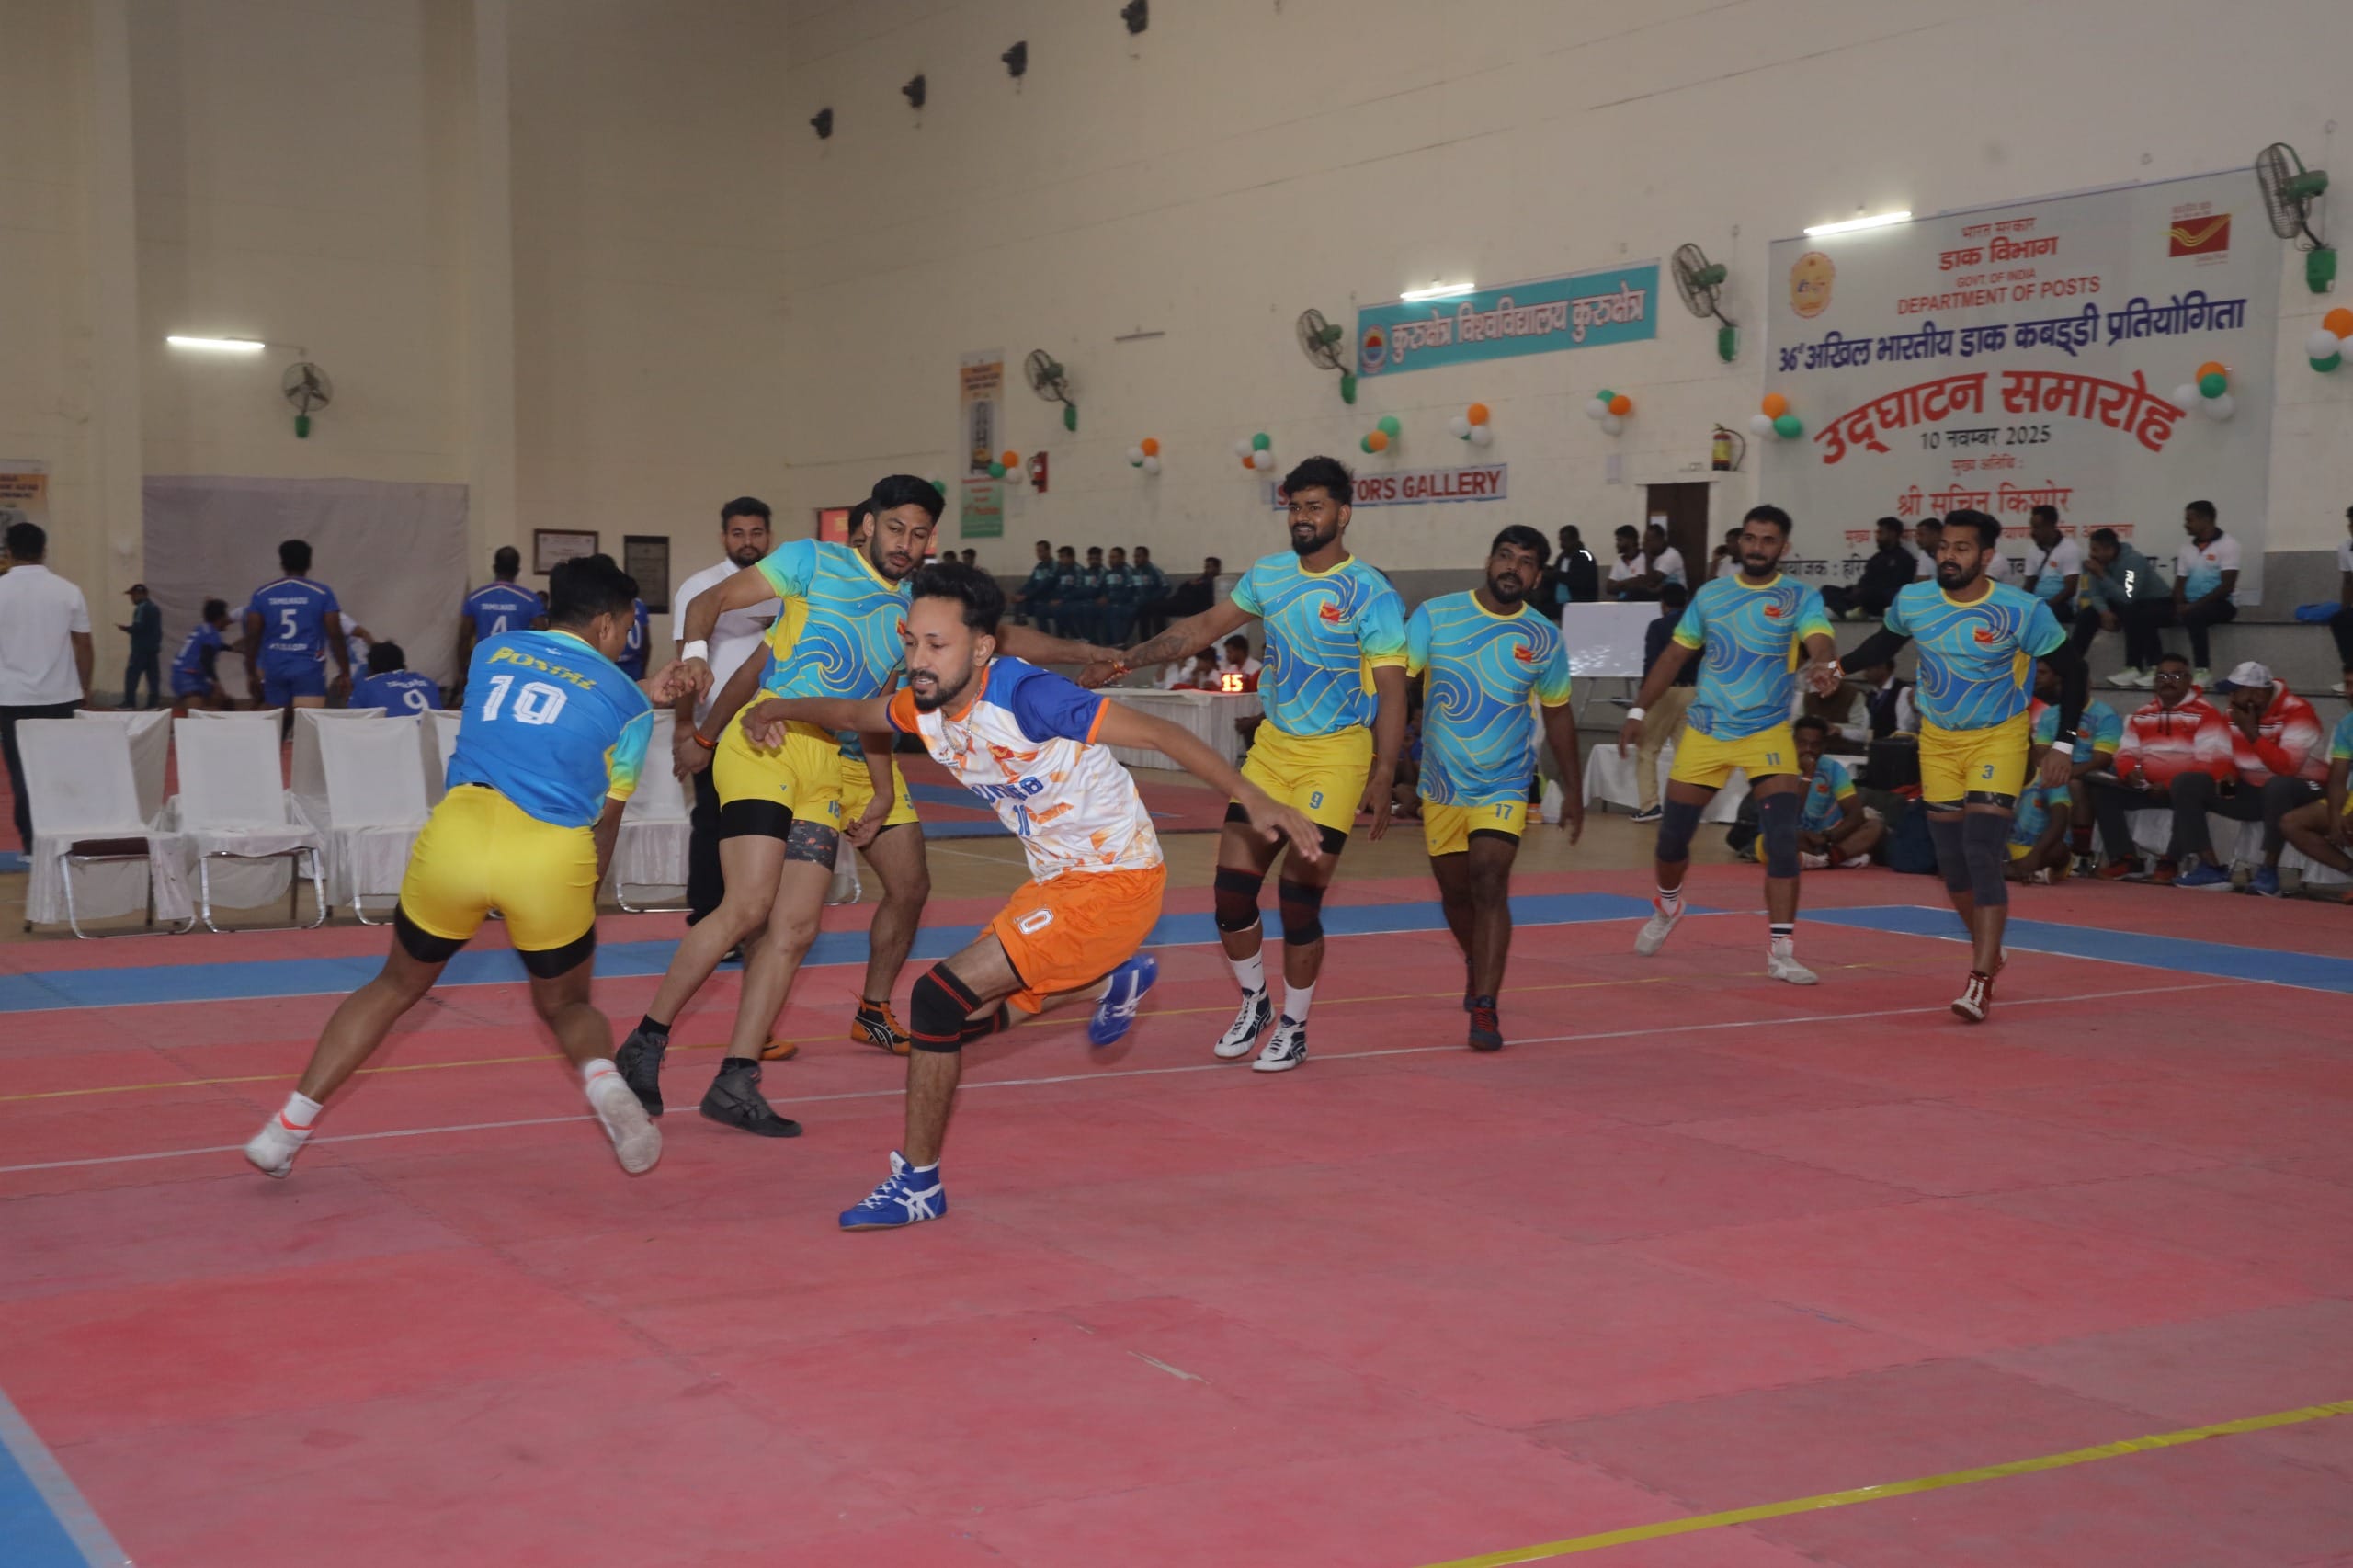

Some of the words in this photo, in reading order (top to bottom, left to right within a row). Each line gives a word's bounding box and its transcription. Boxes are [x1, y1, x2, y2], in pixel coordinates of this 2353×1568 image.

[1961, 223, 1992, 237] भारत
[1938, 246, 1984, 271] डाक
[1989, 236, 2059, 263] विभाग
[1990, 272, 2004, 284] OF
[2007, 268, 2037, 281] INDIA
[1897, 287, 2007, 315] DEPARTMENT
[2012, 284, 2035, 302] OF
[2040, 276, 2101, 299] POSTS
[1392, 308, 1453, 363] कुरुक्षेत्र
[1457, 295, 1568, 343] विश्वविद्यालय
[1572, 281, 1646, 344] कुरुक्षेत्र
[1804, 331, 1873, 369] अखिल
[1876, 321, 1955, 361] भारतीय
[1960, 324, 2006, 358] डाक
[2107, 290, 2248, 347] प्रतियोगिता
[1814, 371, 1987, 463] उद्घाटन
[2000, 369, 2187, 451] समारोह
[1920, 431, 1940, 449] 10
[1946, 428, 1999, 447] नवम्बर
[2006, 425, 2051, 445] 2025
[1403, 470, 1502, 499] GALLERY
[1897, 484, 1924, 516] श्री
[1929, 483, 1991, 515] सचिन
[1998, 479, 2073, 514] किशोर
[279, 608, 298, 640] 5
[490, 616, 506, 633] 4
[1221, 673, 1244, 692] 15
[403, 688, 430, 710] 9
[1764, 752, 1781, 767] 11
[1981, 764, 1995, 780] 3
[1308, 790, 1324, 810] 9
[1494, 803, 1514, 821] 17
